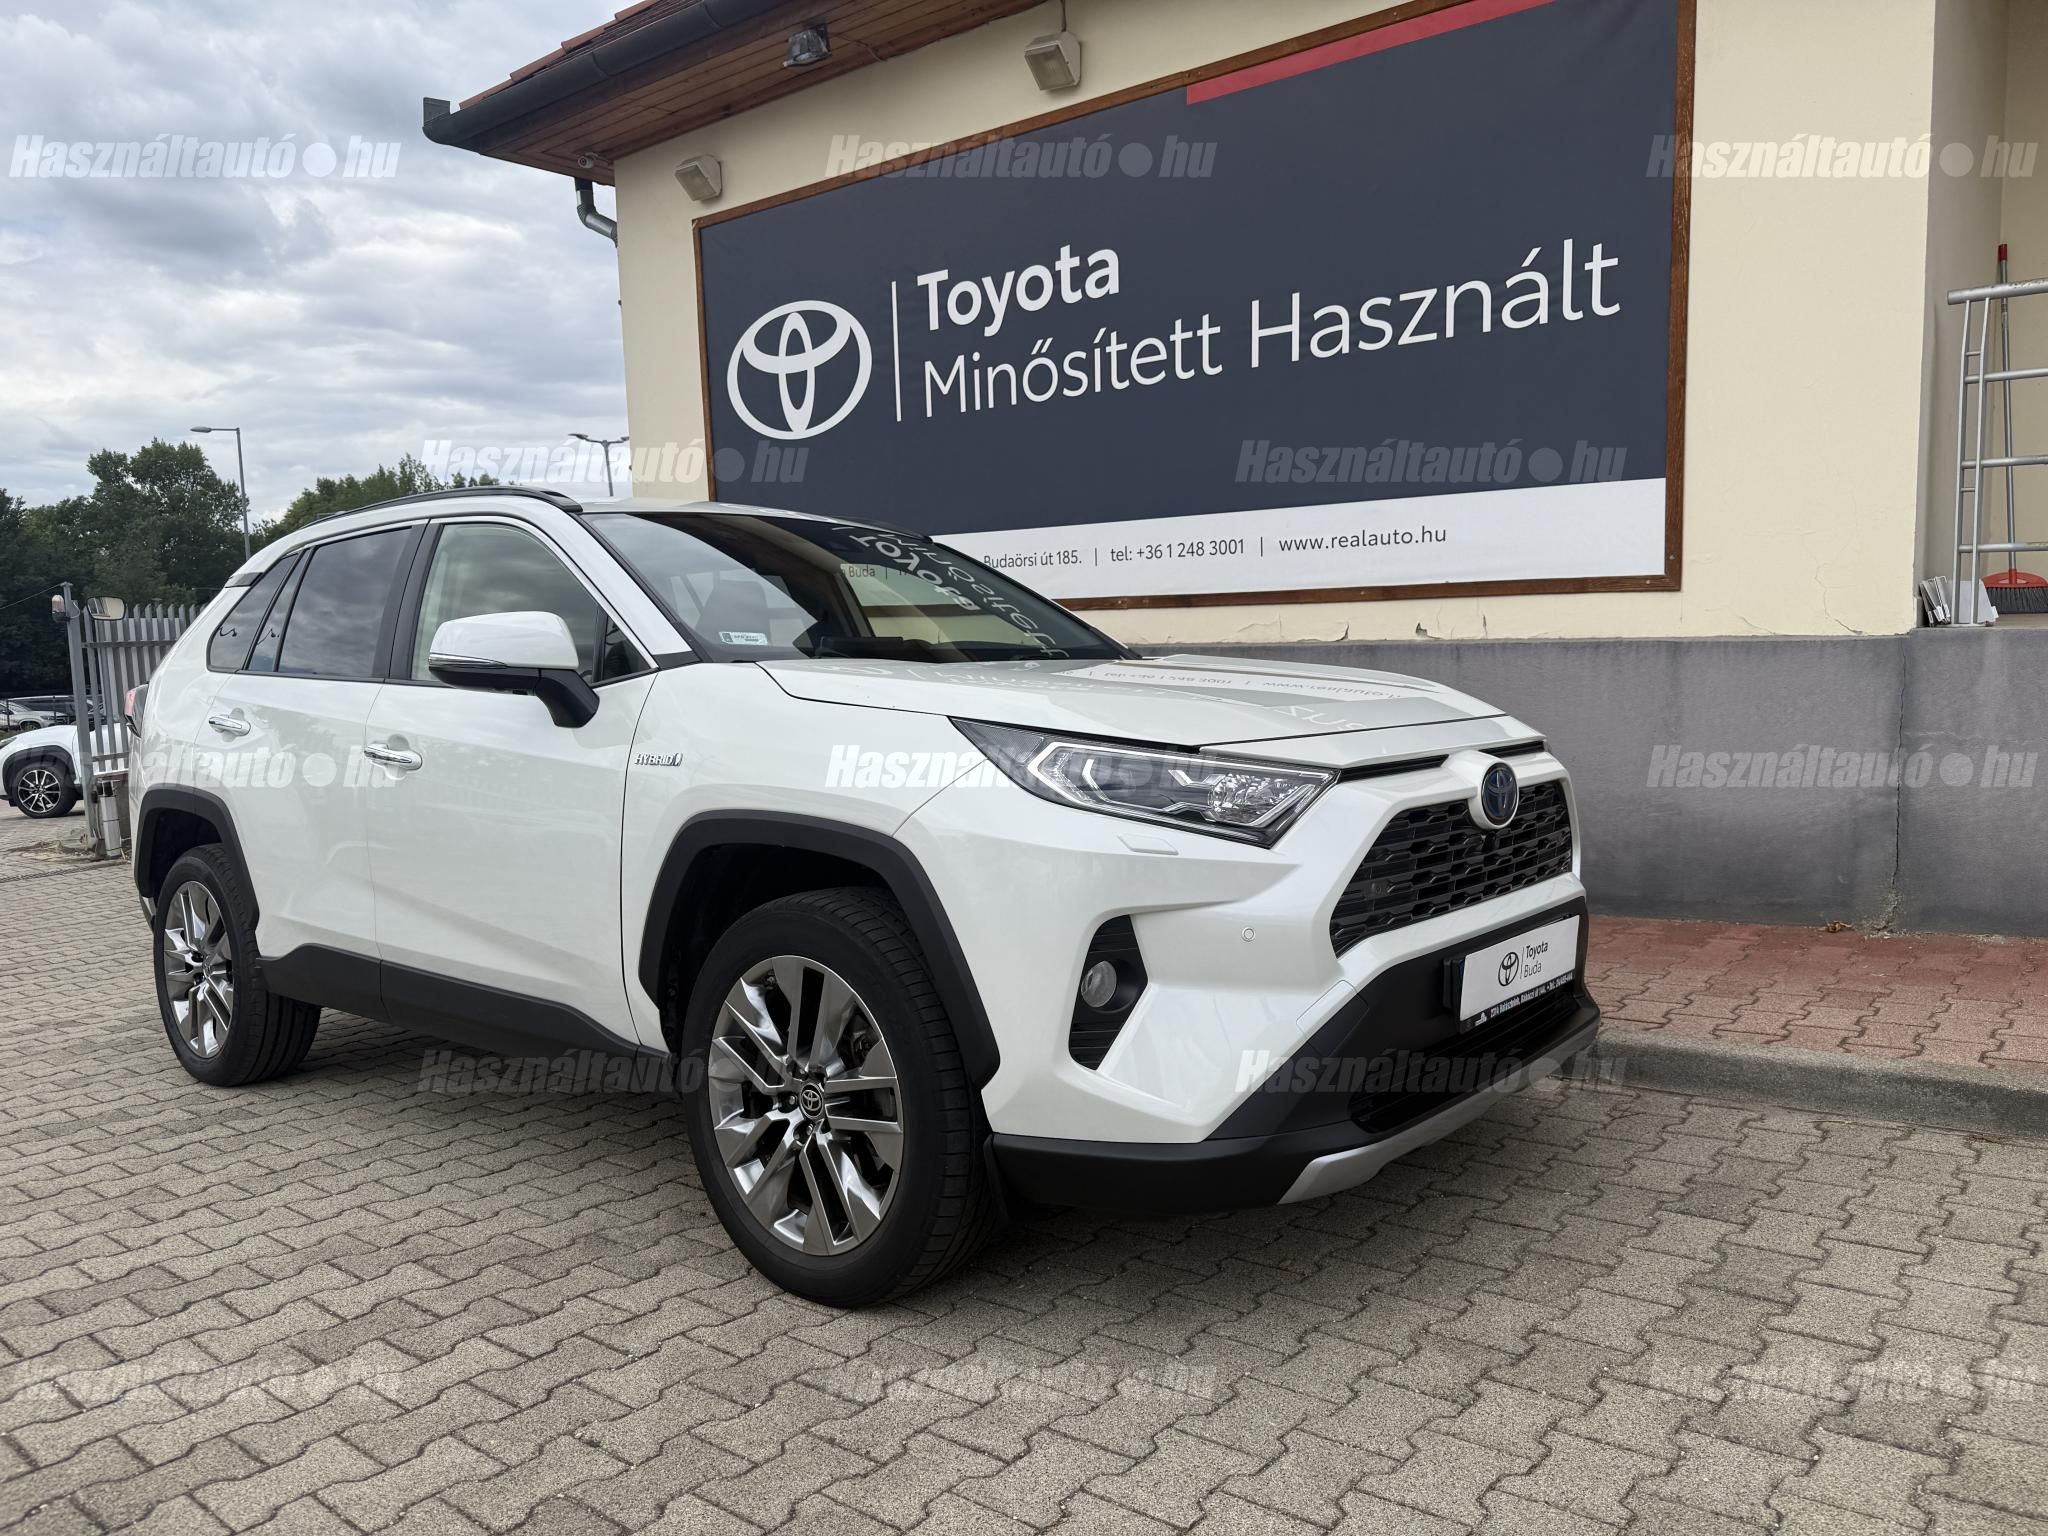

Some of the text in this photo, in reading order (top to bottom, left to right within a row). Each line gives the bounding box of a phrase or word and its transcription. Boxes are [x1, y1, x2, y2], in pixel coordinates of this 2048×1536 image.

[916, 244, 1120, 337] Toyota
[924, 238, 1621, 418] Minősített Használt
[984, 551, 1037, 568] Budaörsi
[1040, 550, 1054, 567] út
[1056, 549, 1083, 565] 185.
[1110, 545, 1133, 562] tel:
[1136, 543, 1163, 560] +36
[1177, 541, 1205, 558] 248
[1208, 538, 1245, 556] 3001
[1278, 525, 1447, 553] www.realauto.hu
[635, 753, 675, 767] HYBRID
[1526, 941, 1549, 960] Toyota
[1523, 960, 1542, 978] Buda
